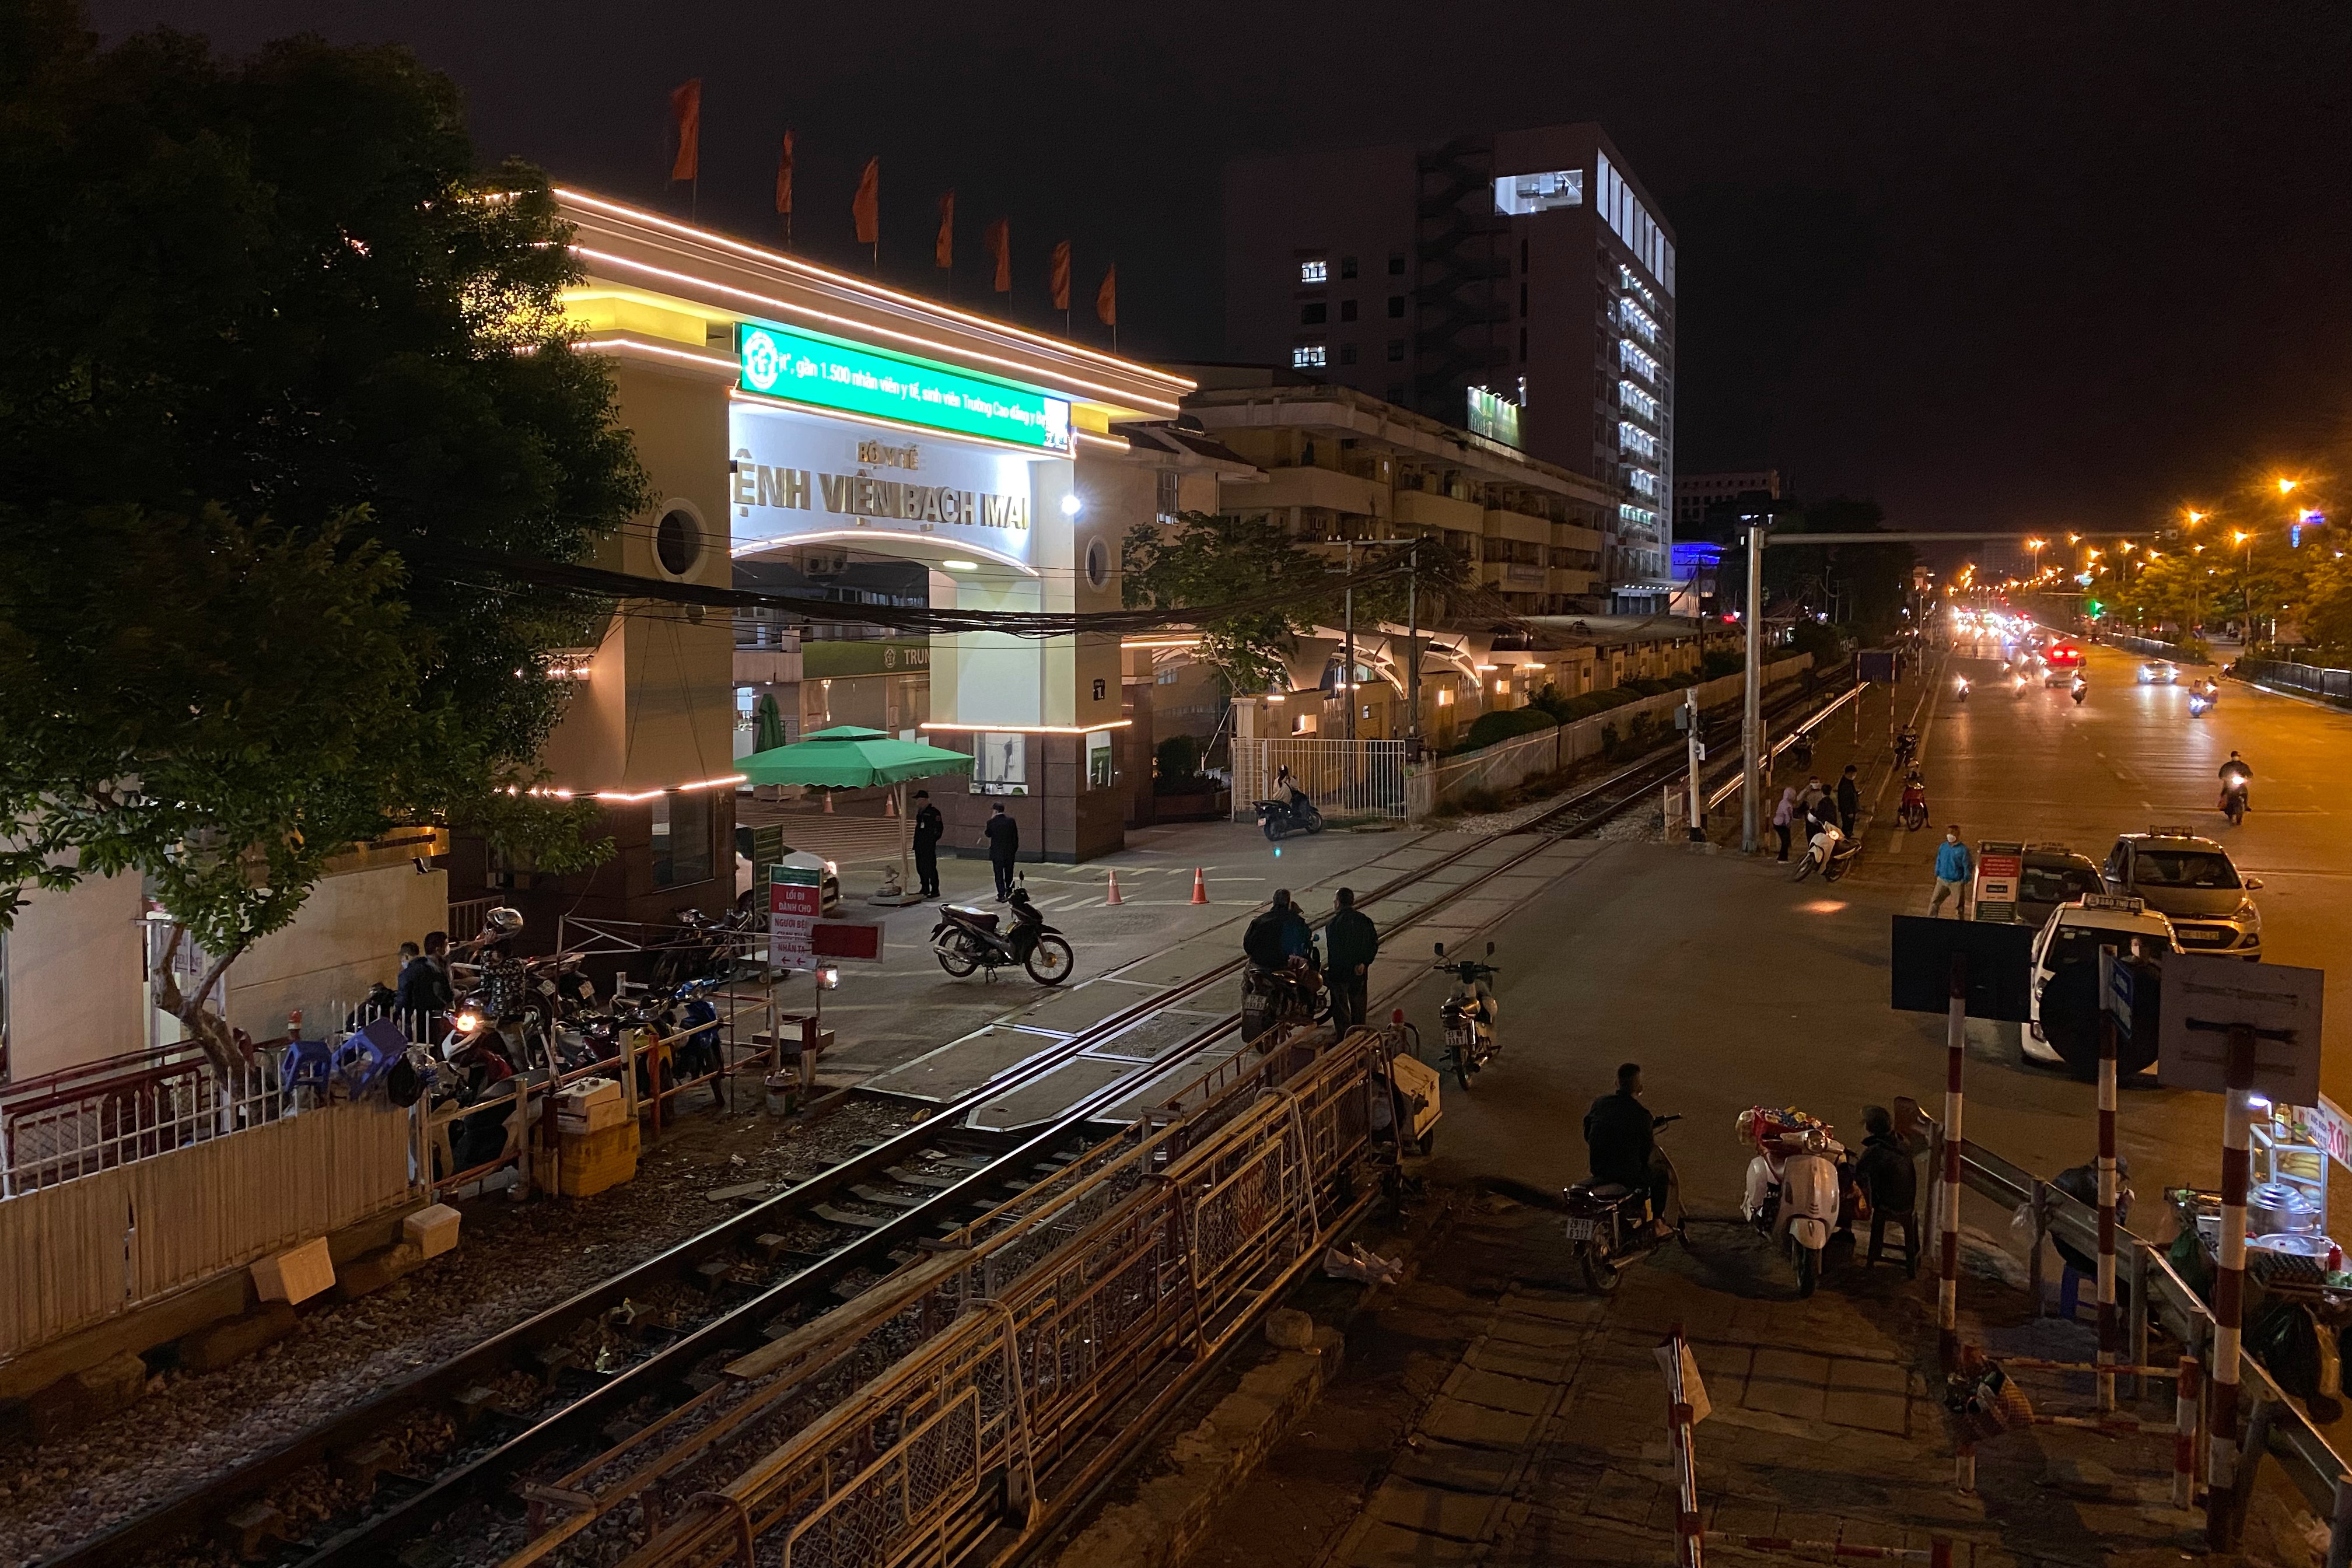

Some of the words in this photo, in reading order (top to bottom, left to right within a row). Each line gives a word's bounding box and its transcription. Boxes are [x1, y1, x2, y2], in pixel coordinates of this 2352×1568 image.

[820, 362, 850, 384] 1.500
[852, 369, 878, 390] nhân
[879, 376, 900, 394] viên
[901, 383, 908, 401] y
[922, 386, 942, 404] sinh
[943, 391, 961, 408] viên
[993, 401, 1010, 418] Cao
[1029, 412, 1035, 427] y
[858, 440, 884, 469] BỘ
[885, 446, 899, 467] Y
[900, 444, 919, 471] TẾ
[733, 448, 811, 517] ỆNH
[817, 469, 894, 526] VIỆN
[900, 482, 976, 531] BẠCH
[981, 492, 1029, 529] MAI
[904, 648, 929, 665] TRUN
[1096, 687, 1102, 699] 1
[786, 889, 796, 900] LỐI
[797, 892, 804, 901] ĐI
[798, 904, 811, 913] CHO
[775, 918, 796, 928] NGƯỜI
[797, 919, 807, 931] BỆ
[778, 943, 797, 953] NHÂN
[797, 945, 806, 956] TẠ
